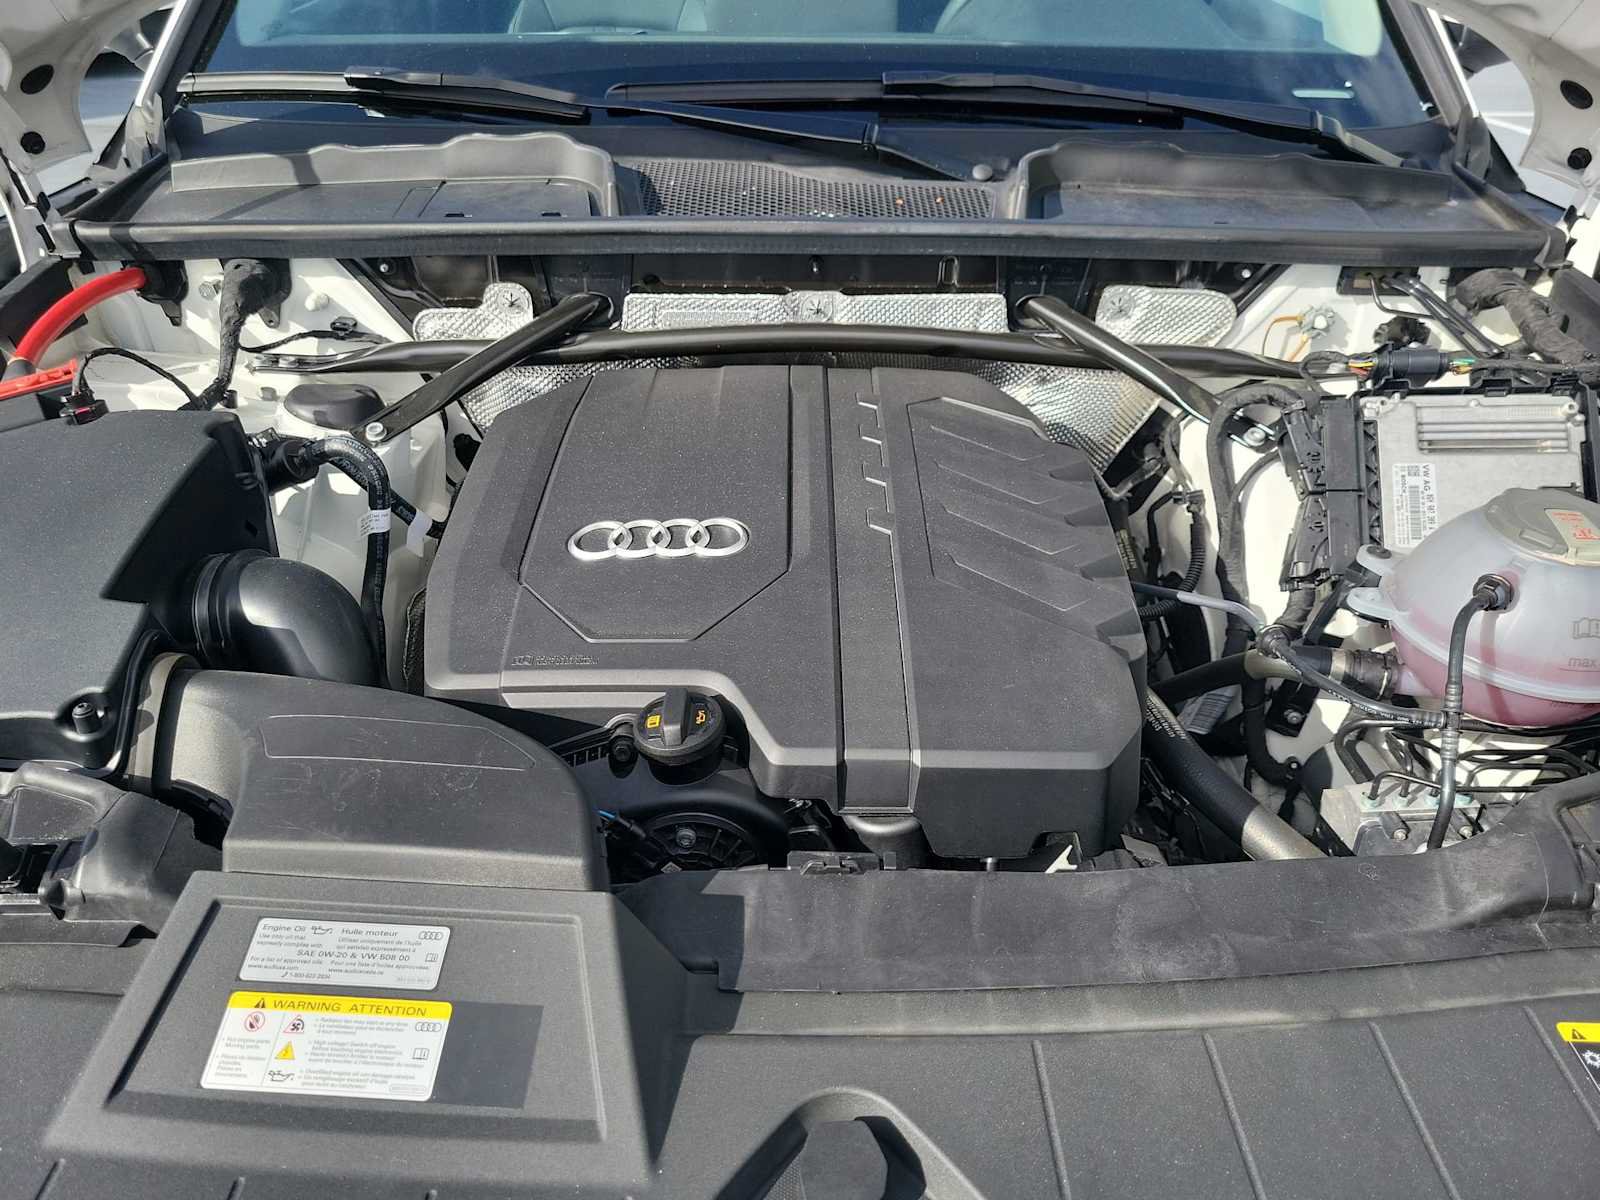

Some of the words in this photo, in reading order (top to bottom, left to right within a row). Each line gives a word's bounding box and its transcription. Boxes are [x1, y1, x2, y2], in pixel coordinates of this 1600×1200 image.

[1422, 464, 1431, 477] VW
[1423, 480, 1431, 492] AG
[263, 924, 292, 932] Engine
[365, 929, 398, 937] moteur
[296, 949, 314, 957] SAE
[317, 950, 348, 958] 0W-20
[360, 952, 378, 960] VW
[398, 953, 410, 962] 00
[273, 999, 342, 1012] WARNING
[350, 1003, 428, 1017] ATTENTION
